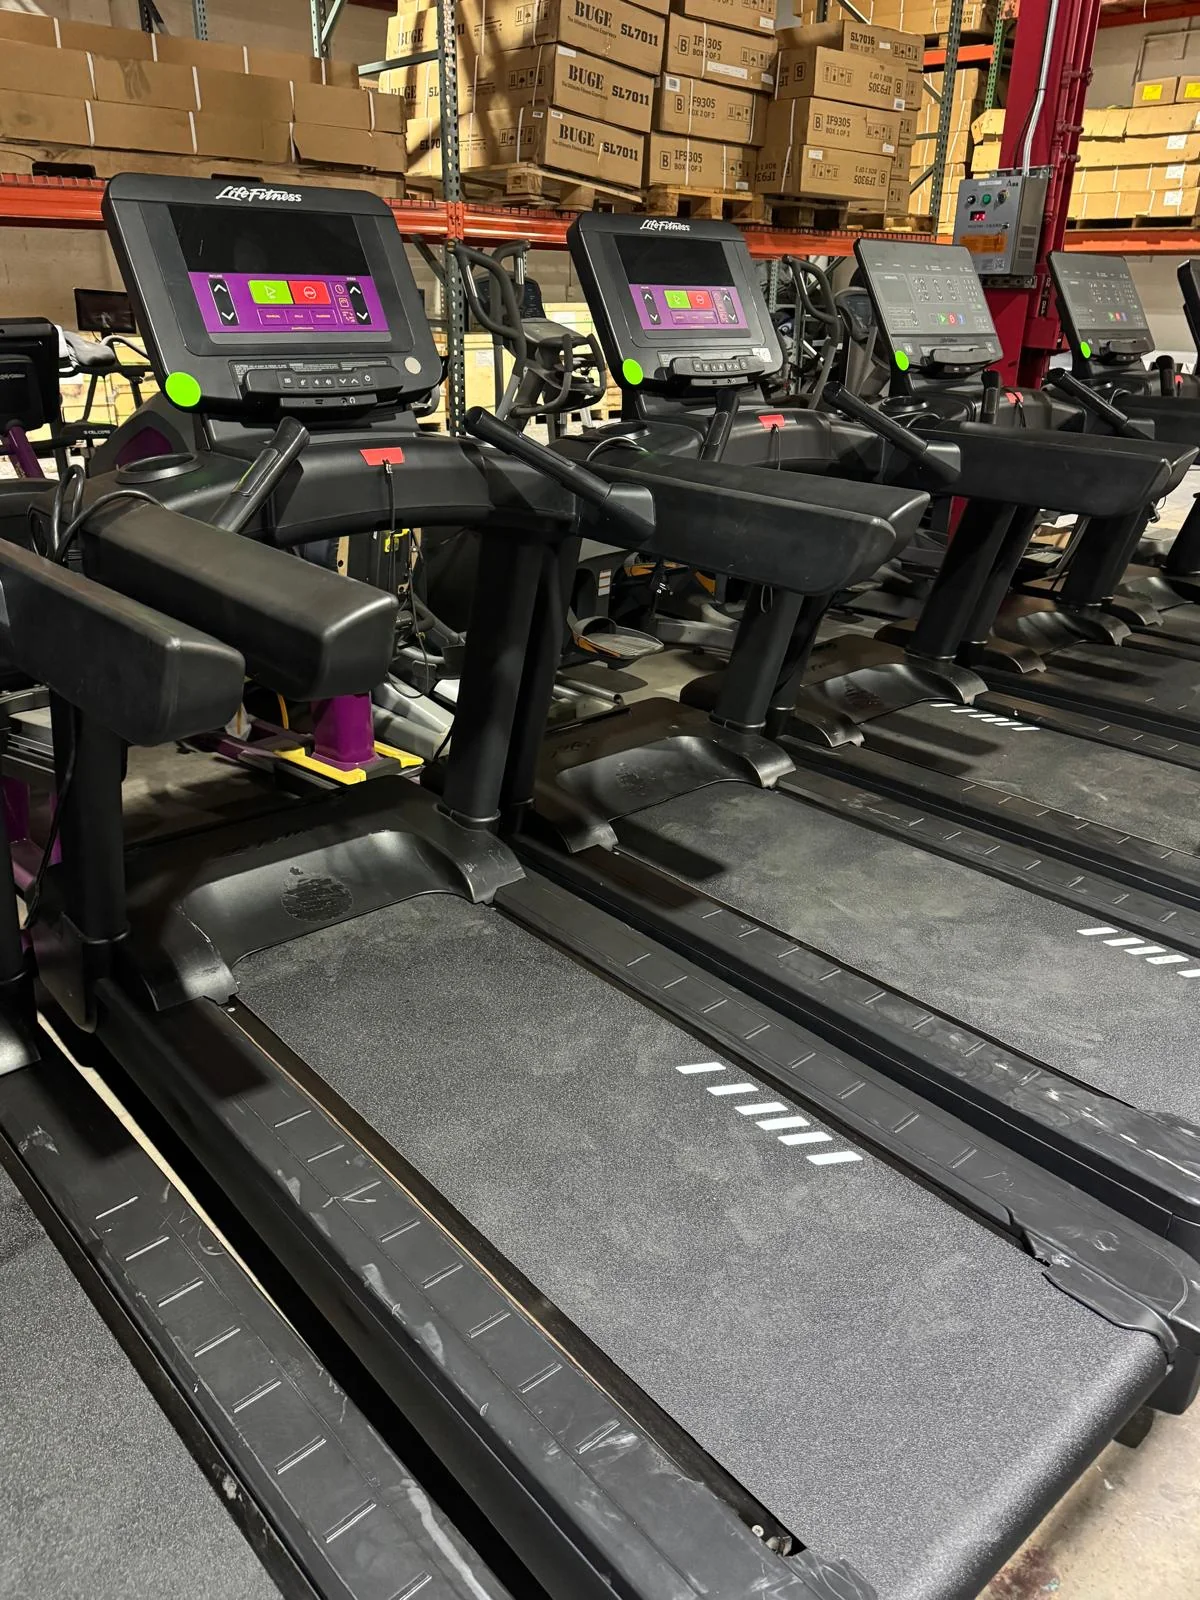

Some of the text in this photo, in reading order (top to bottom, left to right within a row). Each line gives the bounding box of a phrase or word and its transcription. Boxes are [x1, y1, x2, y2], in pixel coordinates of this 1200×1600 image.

[575, 0, 613, 29] BUGE
[397, 27, 424, 46] BUGE
[620, 23, 659, 47] SL7011
[850, 31, 875, 46] SL7016
[680, 39, 687, 52] B
[568, 64, 605, 91] BUGE
[611, 84, 649, 106] SL7011
[676, 98, 683, 111] B
[815, 114, 851, 128] B IF9305
[559, 123, 595, 147] BUGE
[420, 138, 441, 151] SL70
[603, 141, 639, 161] SL7011
[662, 149, 703, 167] B IF9305
[754, 171, 777, 182] IF93
